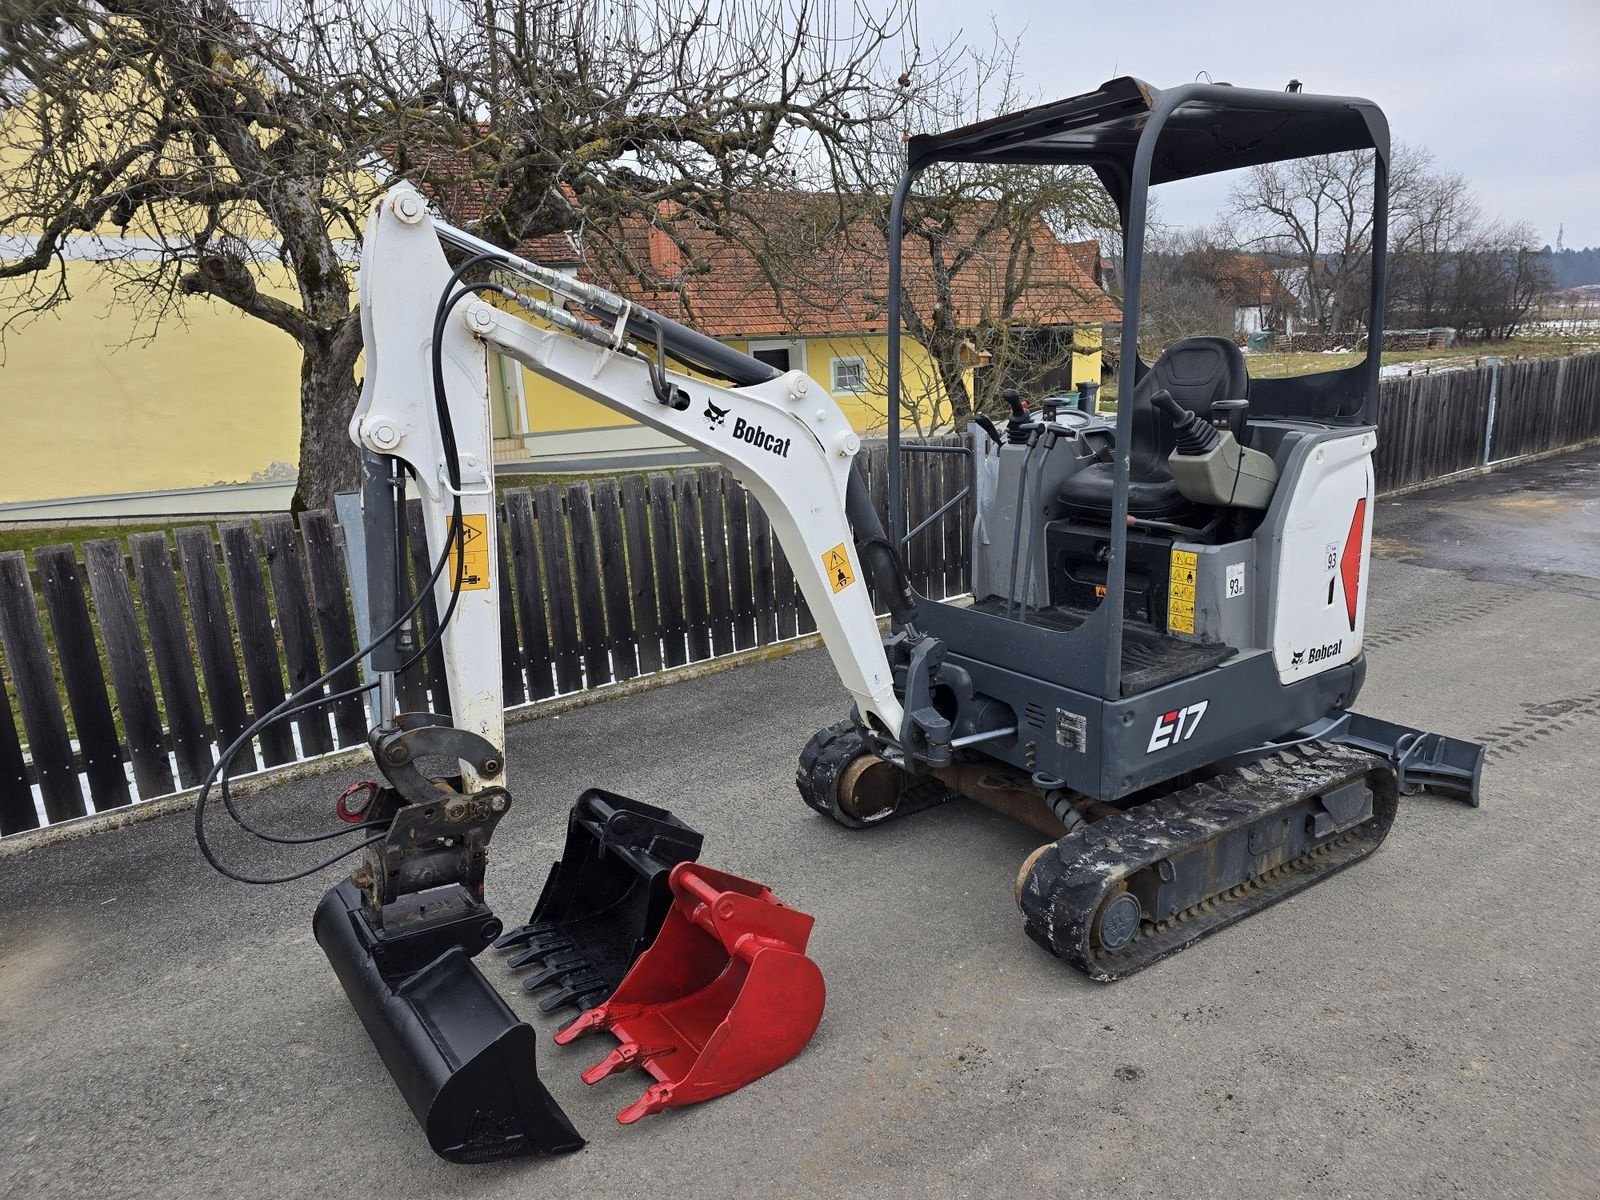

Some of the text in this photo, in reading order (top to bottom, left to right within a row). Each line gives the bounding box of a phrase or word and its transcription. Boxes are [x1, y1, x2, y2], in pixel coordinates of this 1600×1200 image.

[732, 416, 791, 459] Bobcat
[1327, 552, 1337, 570] 93
[1229, 578, 1239, 596] 93
[1308, 638, 1343, 664] Bobcat
[1146, 699, 1209, 753] E17
